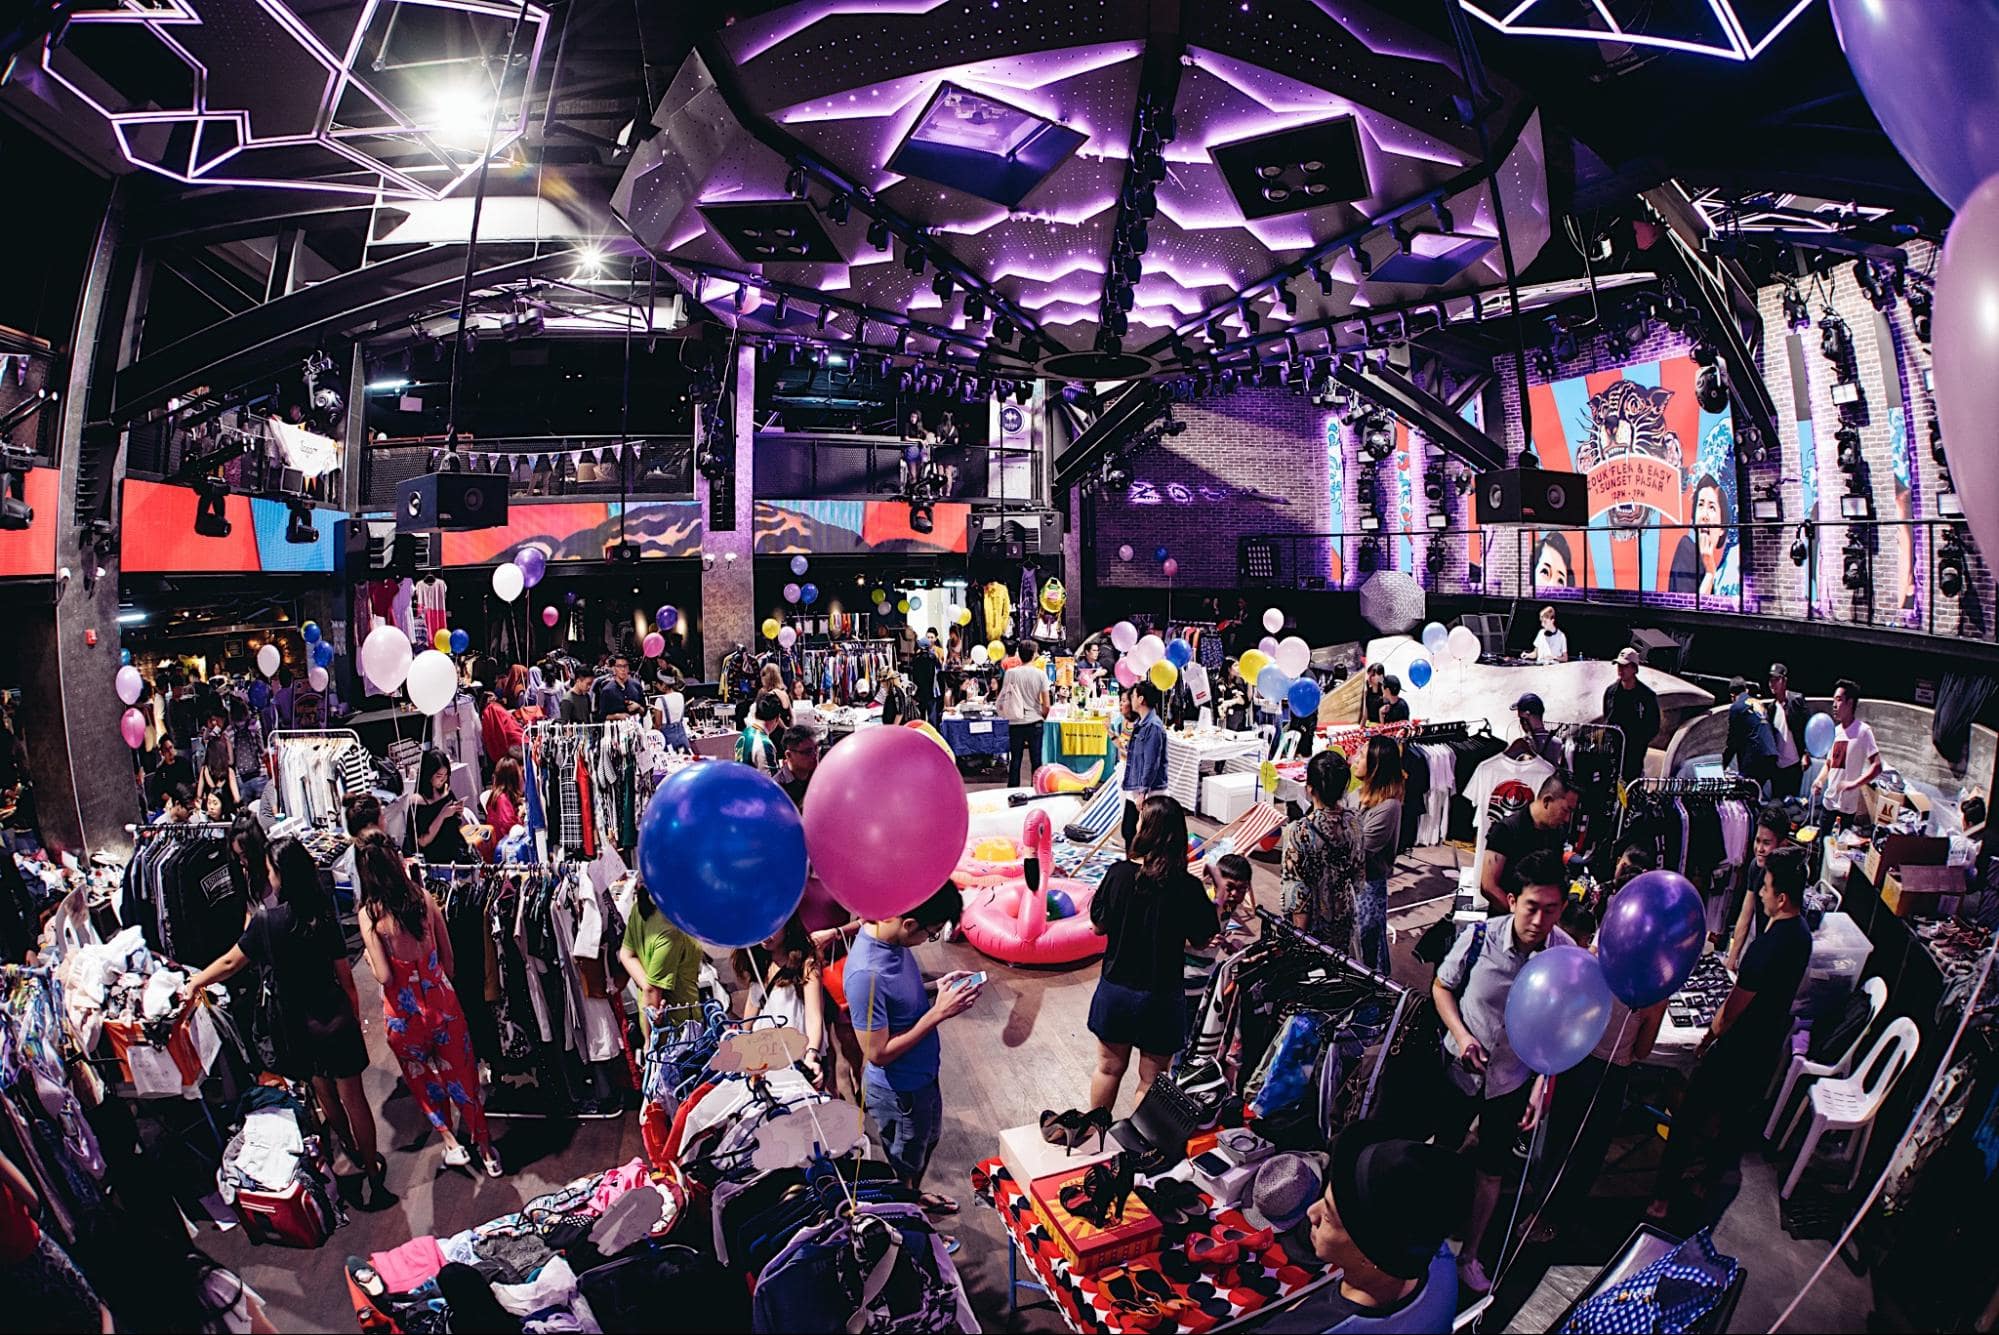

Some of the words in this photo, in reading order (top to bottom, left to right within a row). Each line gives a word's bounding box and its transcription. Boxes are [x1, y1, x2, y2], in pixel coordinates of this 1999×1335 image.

[1609, 463, 1634, 476] FLEA
[1637, 463, 1643, 474] &
[1647, 465, 1672, 484] EASY
[1600, 475, 1632, 493] SUNSET
[1635, 475, 1664, 492] PASAR
